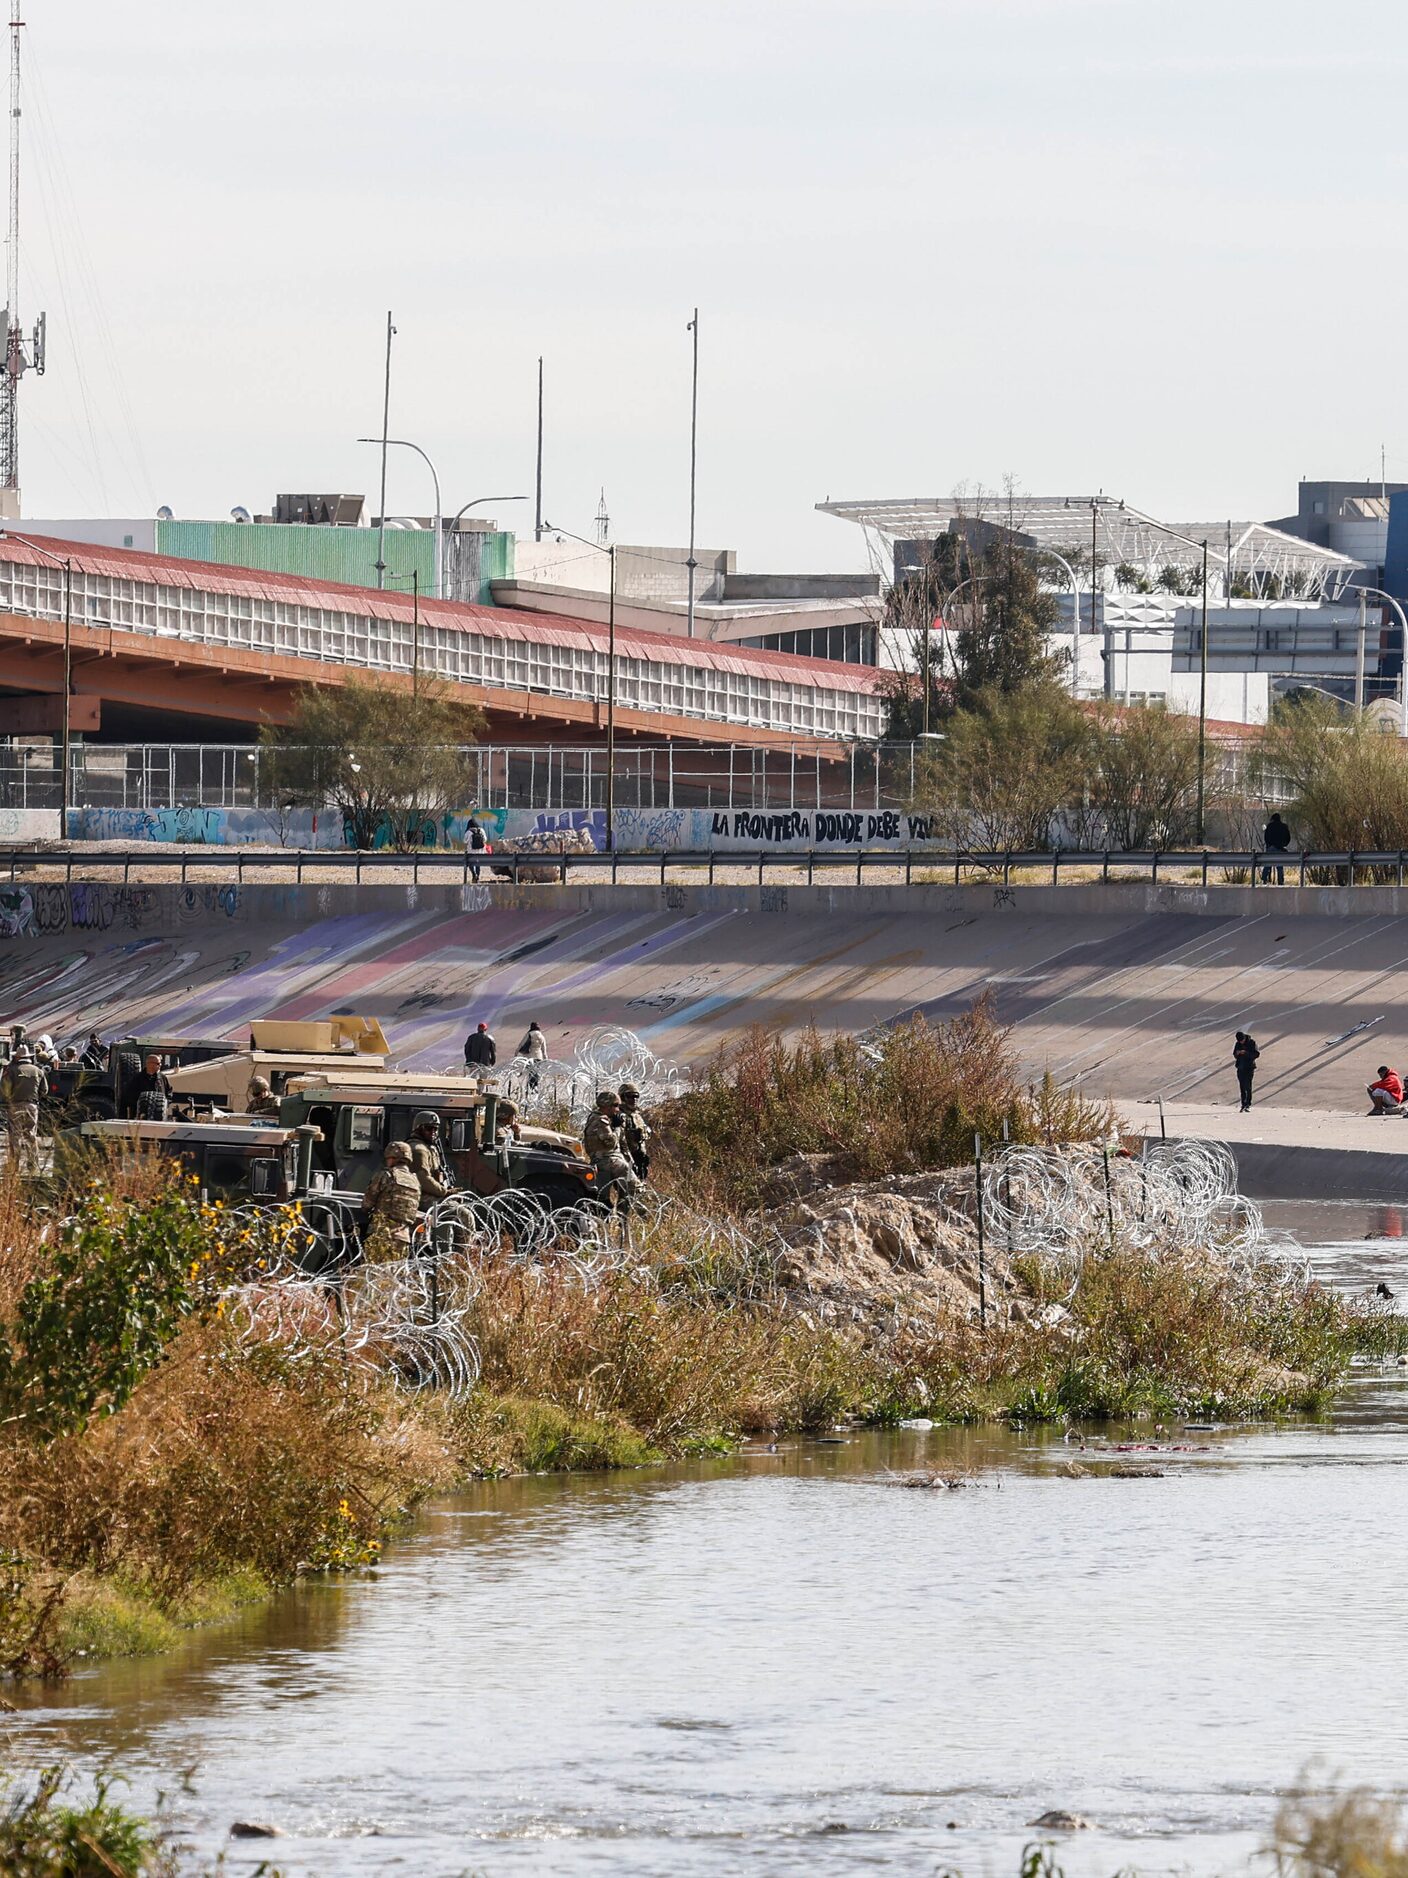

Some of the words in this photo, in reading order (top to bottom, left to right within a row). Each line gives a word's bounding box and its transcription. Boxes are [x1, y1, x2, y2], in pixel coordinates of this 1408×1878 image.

[712, 812, 730, 836] LA
[733, 811, 810, 842] FRONTERA
[815, 813, 863, 844] DONDE
[867, 811, 900, 841] DEBE
